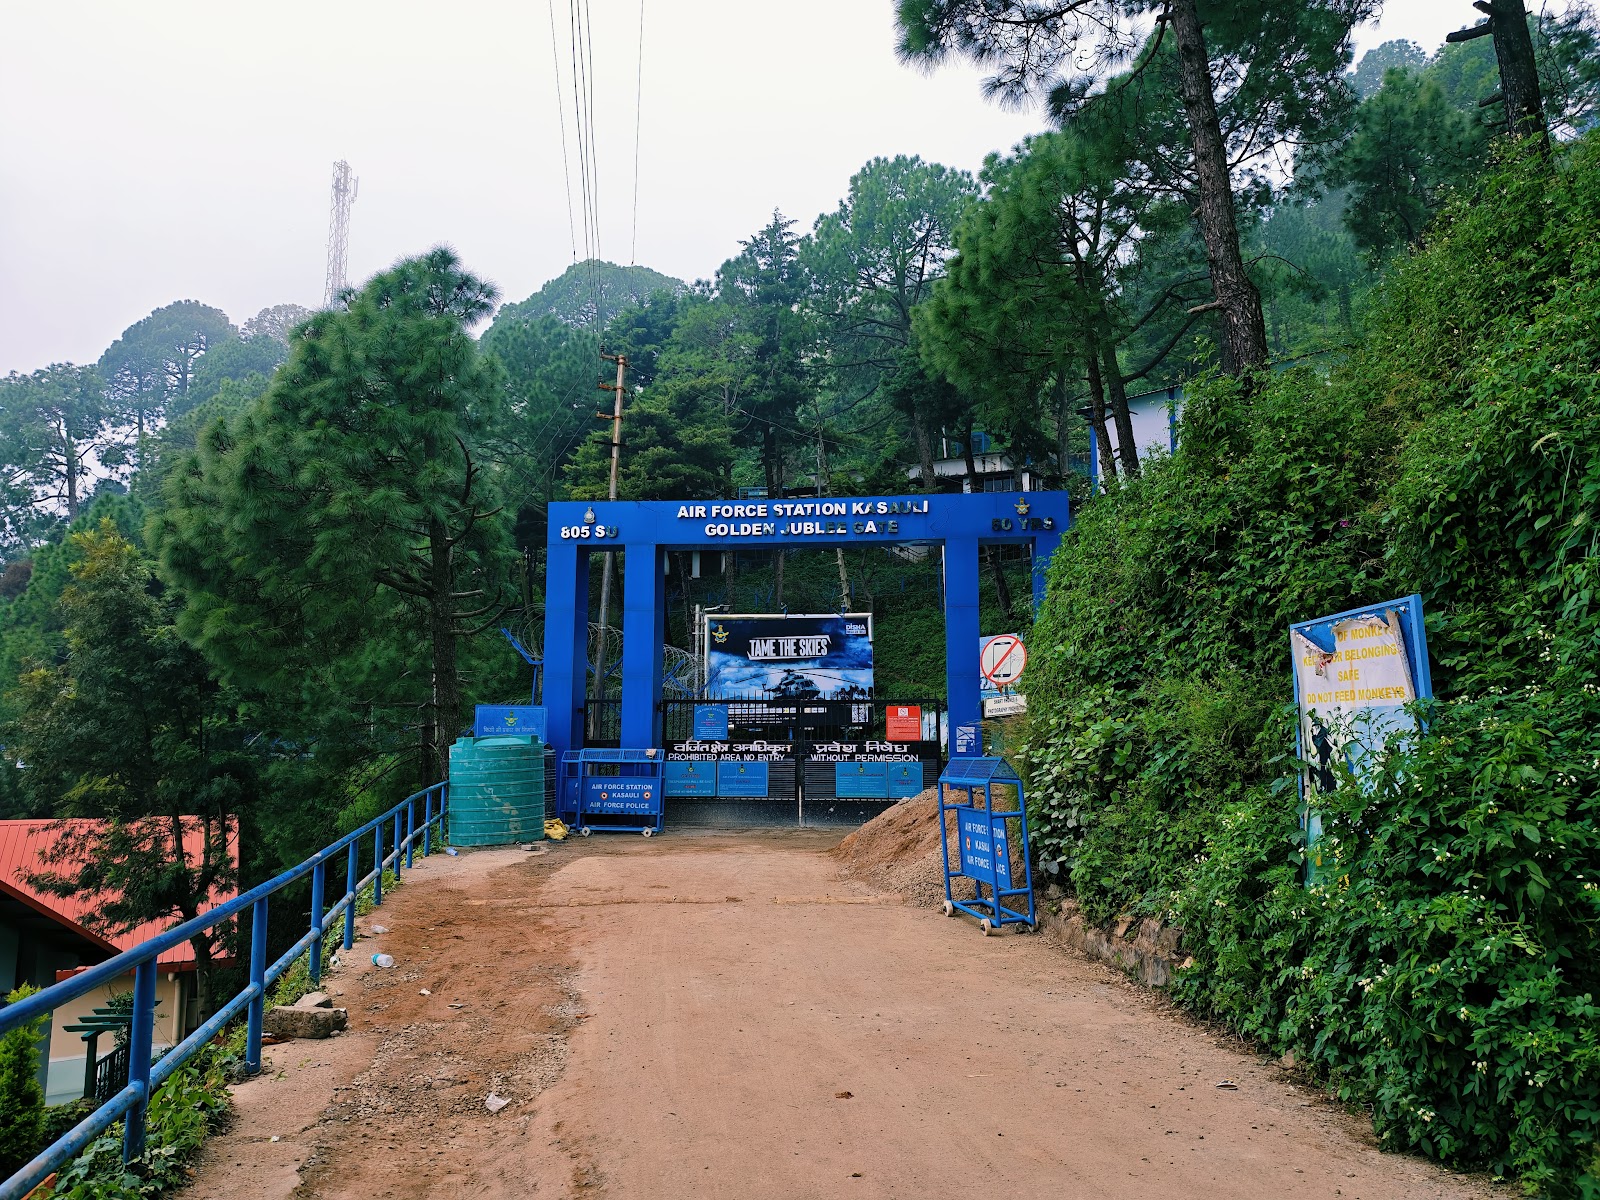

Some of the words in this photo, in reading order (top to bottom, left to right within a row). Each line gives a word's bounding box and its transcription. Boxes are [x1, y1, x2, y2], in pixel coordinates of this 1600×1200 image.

[677, 505, 706, 518] AIR
[711, 503, 768, 517] FORCE
[772, 502, 847, 517] STATION
[852, 500, 929, 515] KASAULI
[560, 525, 590, 539] 805
[594, 525, 618, 538] SU
[704, 522, 775, 537] GOLDEN
[780, 521, 847, 535] JUBLEE
[852, 520, 899, 534] GATE
[1337, 630, 1349, 642] OF
[749, 639, 776, 657] TAME
[778, 639, 797, 656] THE
[799, 638, 828, 656] SKIES
[1337, 669, 1360, 682] SAFE
[1307, 693, 1316, 704] DO
[1318, 692, 1332, 703] NOT
[1334, 690, 1355, 703] FEED
[1358, 686, 1405, 701] MONKEYS
[673, 740, 710, 752] वर्जित
[711, 740, 729, 753] क्षेत्र
[813, 741, 858, 754] प्रवेश
[863, 740, 910, 753] निषेध
[668, 753, 718, 761] PROHIBITED
[720, 753, 741, 761] AREA
[743, 753, 755, 761] NO
[757, 753, 785, 761] ENTRY
[811, 753, 850, 762] WITHOUT
[855, 754, 919, 762] PERMISSION
[972, 823, 986, 835] FORCE
[974, 856, 989, 870] FORCE
